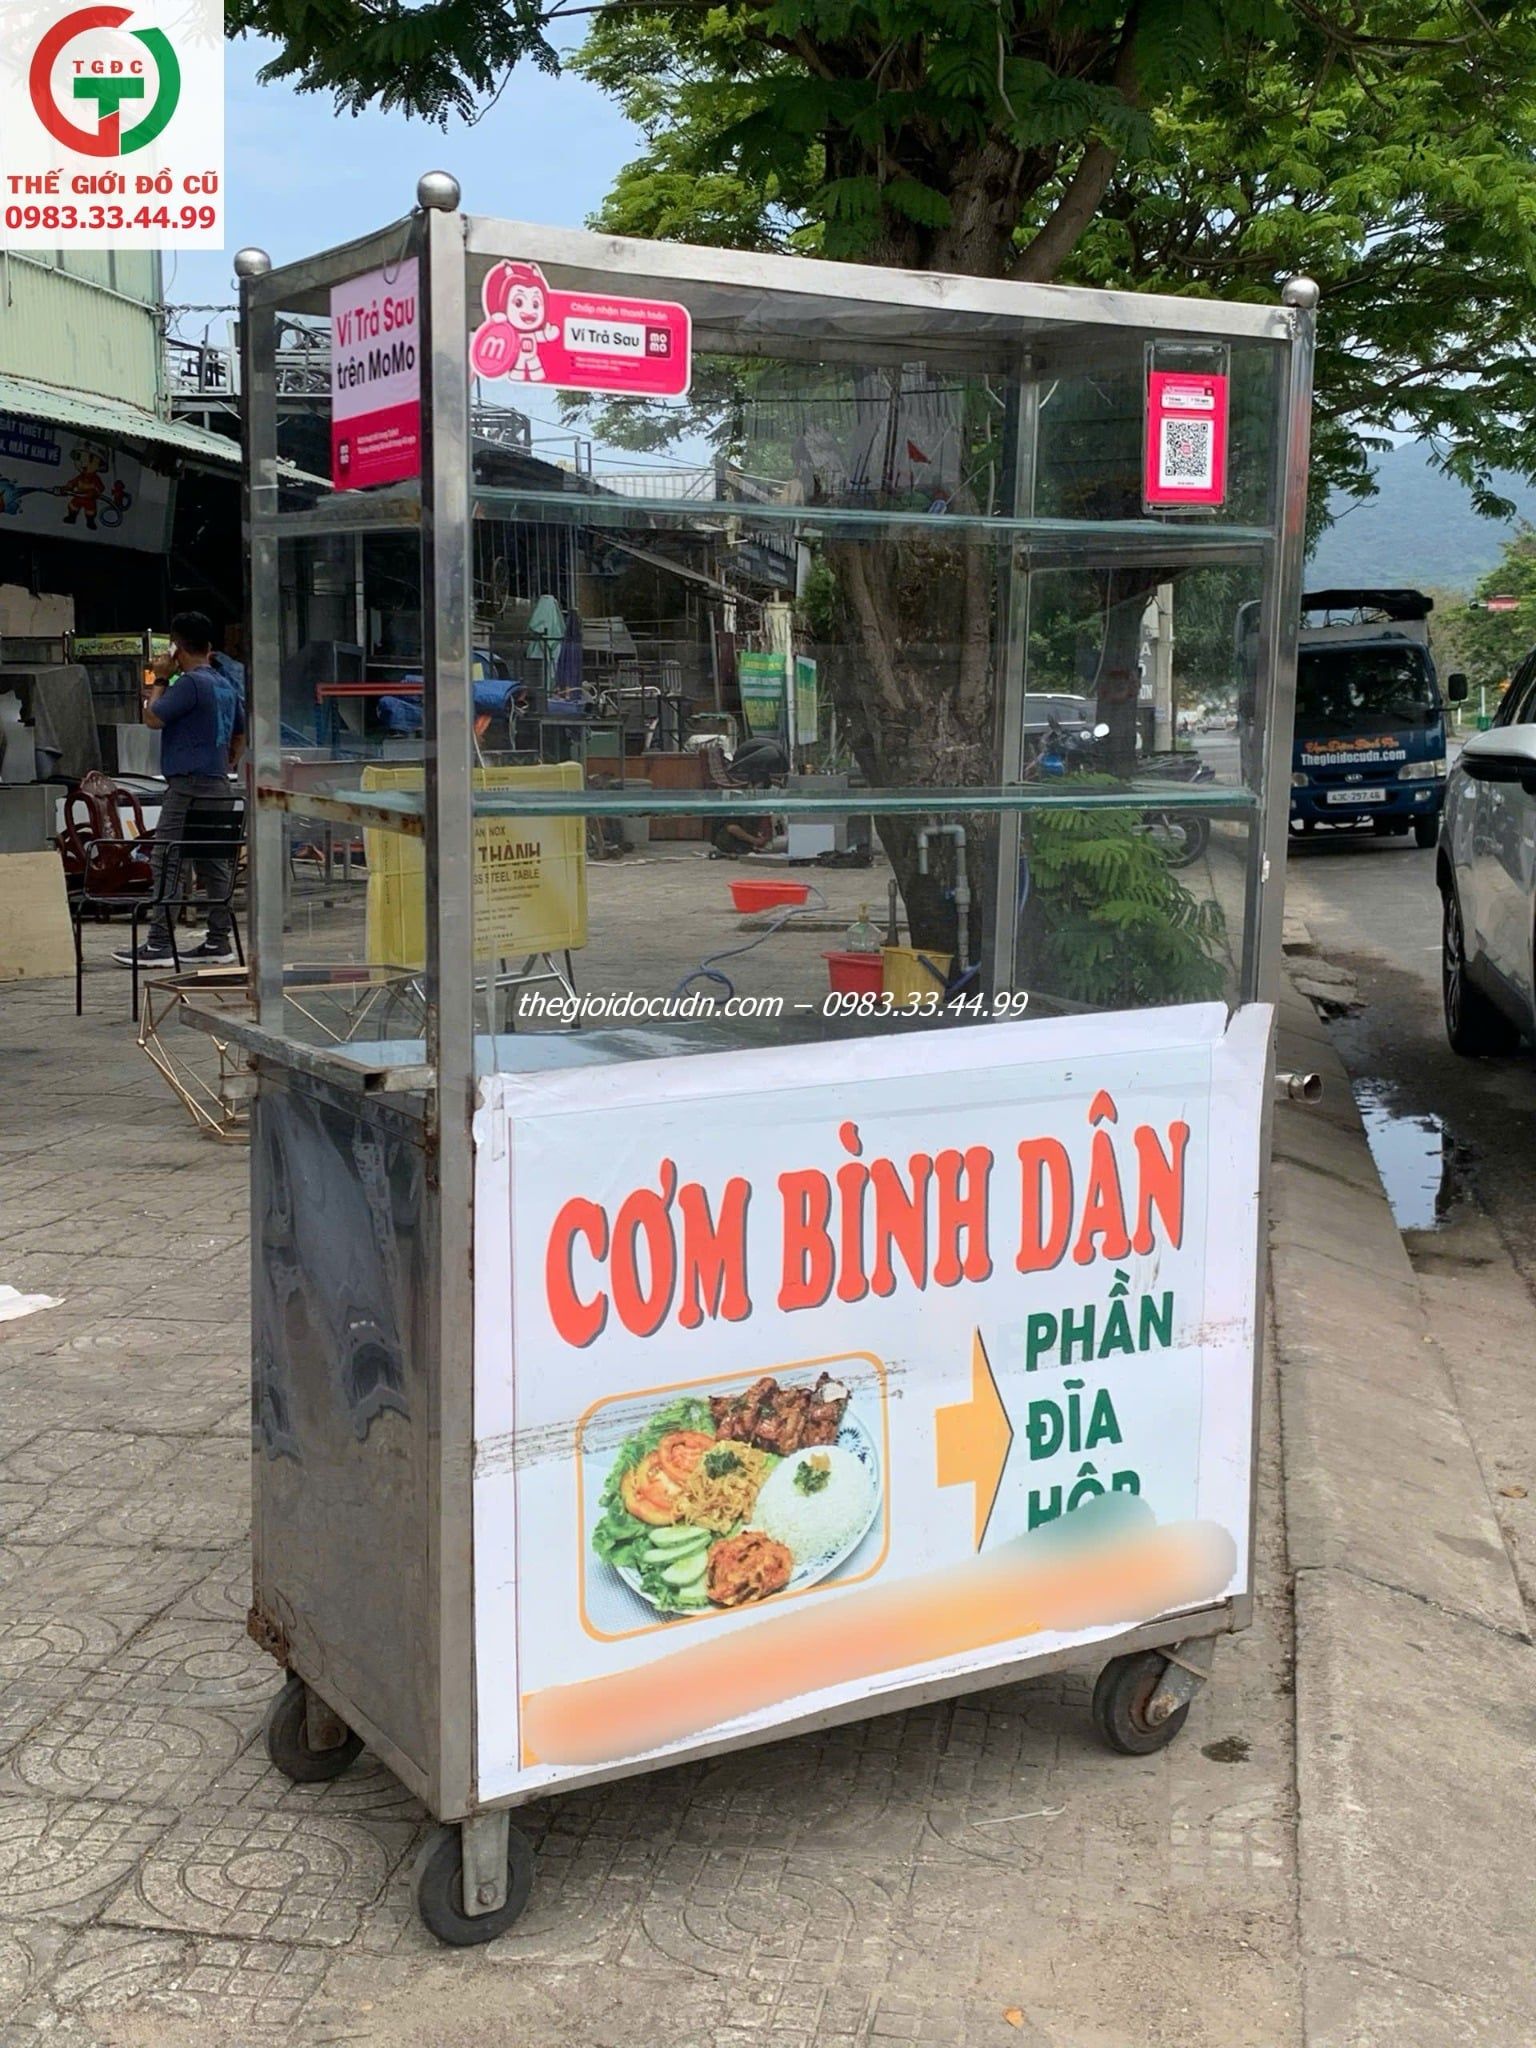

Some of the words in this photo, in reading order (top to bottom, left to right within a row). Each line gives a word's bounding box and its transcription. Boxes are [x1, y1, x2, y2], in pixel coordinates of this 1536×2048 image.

[337, 310, 352, 347] Ví
[354, 300, 379, 341] Trả
[384, 297, 414, 332] Sau
[571, 327, 585, 342] Ví
[588, 329, 610, 344] Trả
[613, 332, 640, 347] Sau
[337, 356, 365, 389] trên
[369, 341, 415, 381] MoMo
[512, 868, 540, 881] TABLE
[546, 1158, 752, 1349] CƠM
[777, 1120, 994, 1312] BÌNH
[1015, 1088, 1191, 1276] DÂN
[1026, 1268, 1174, 1372] PHẦN
[1026, 1379, 1123, 1461] ĐĨA
